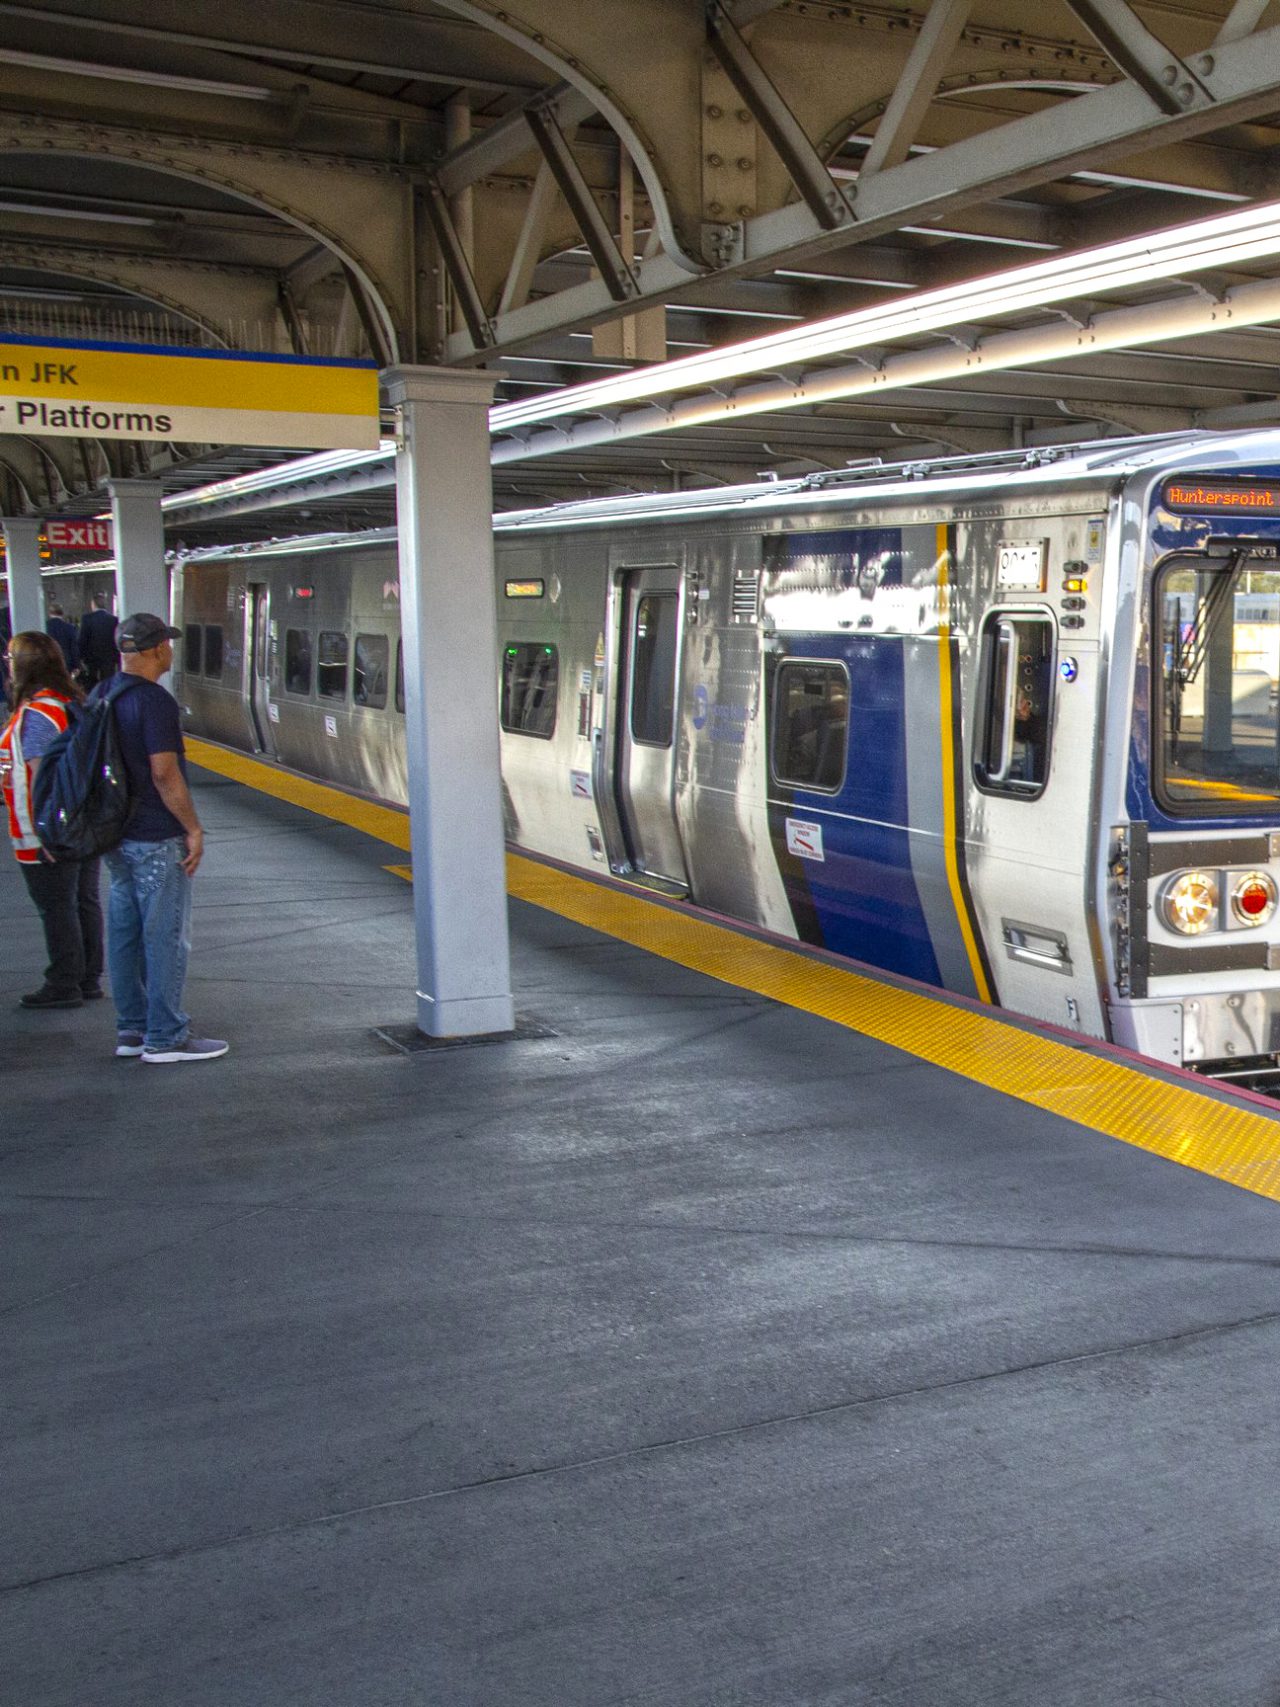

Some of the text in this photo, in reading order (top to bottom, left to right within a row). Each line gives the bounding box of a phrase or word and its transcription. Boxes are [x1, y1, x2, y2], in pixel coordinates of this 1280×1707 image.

[31, 362, 78, 385] JFK
[17, 401, 172, 433] Platforms
[1169, 488, 1274, 506] Hunterspoint
[47, 522, 106, 545] Exit
